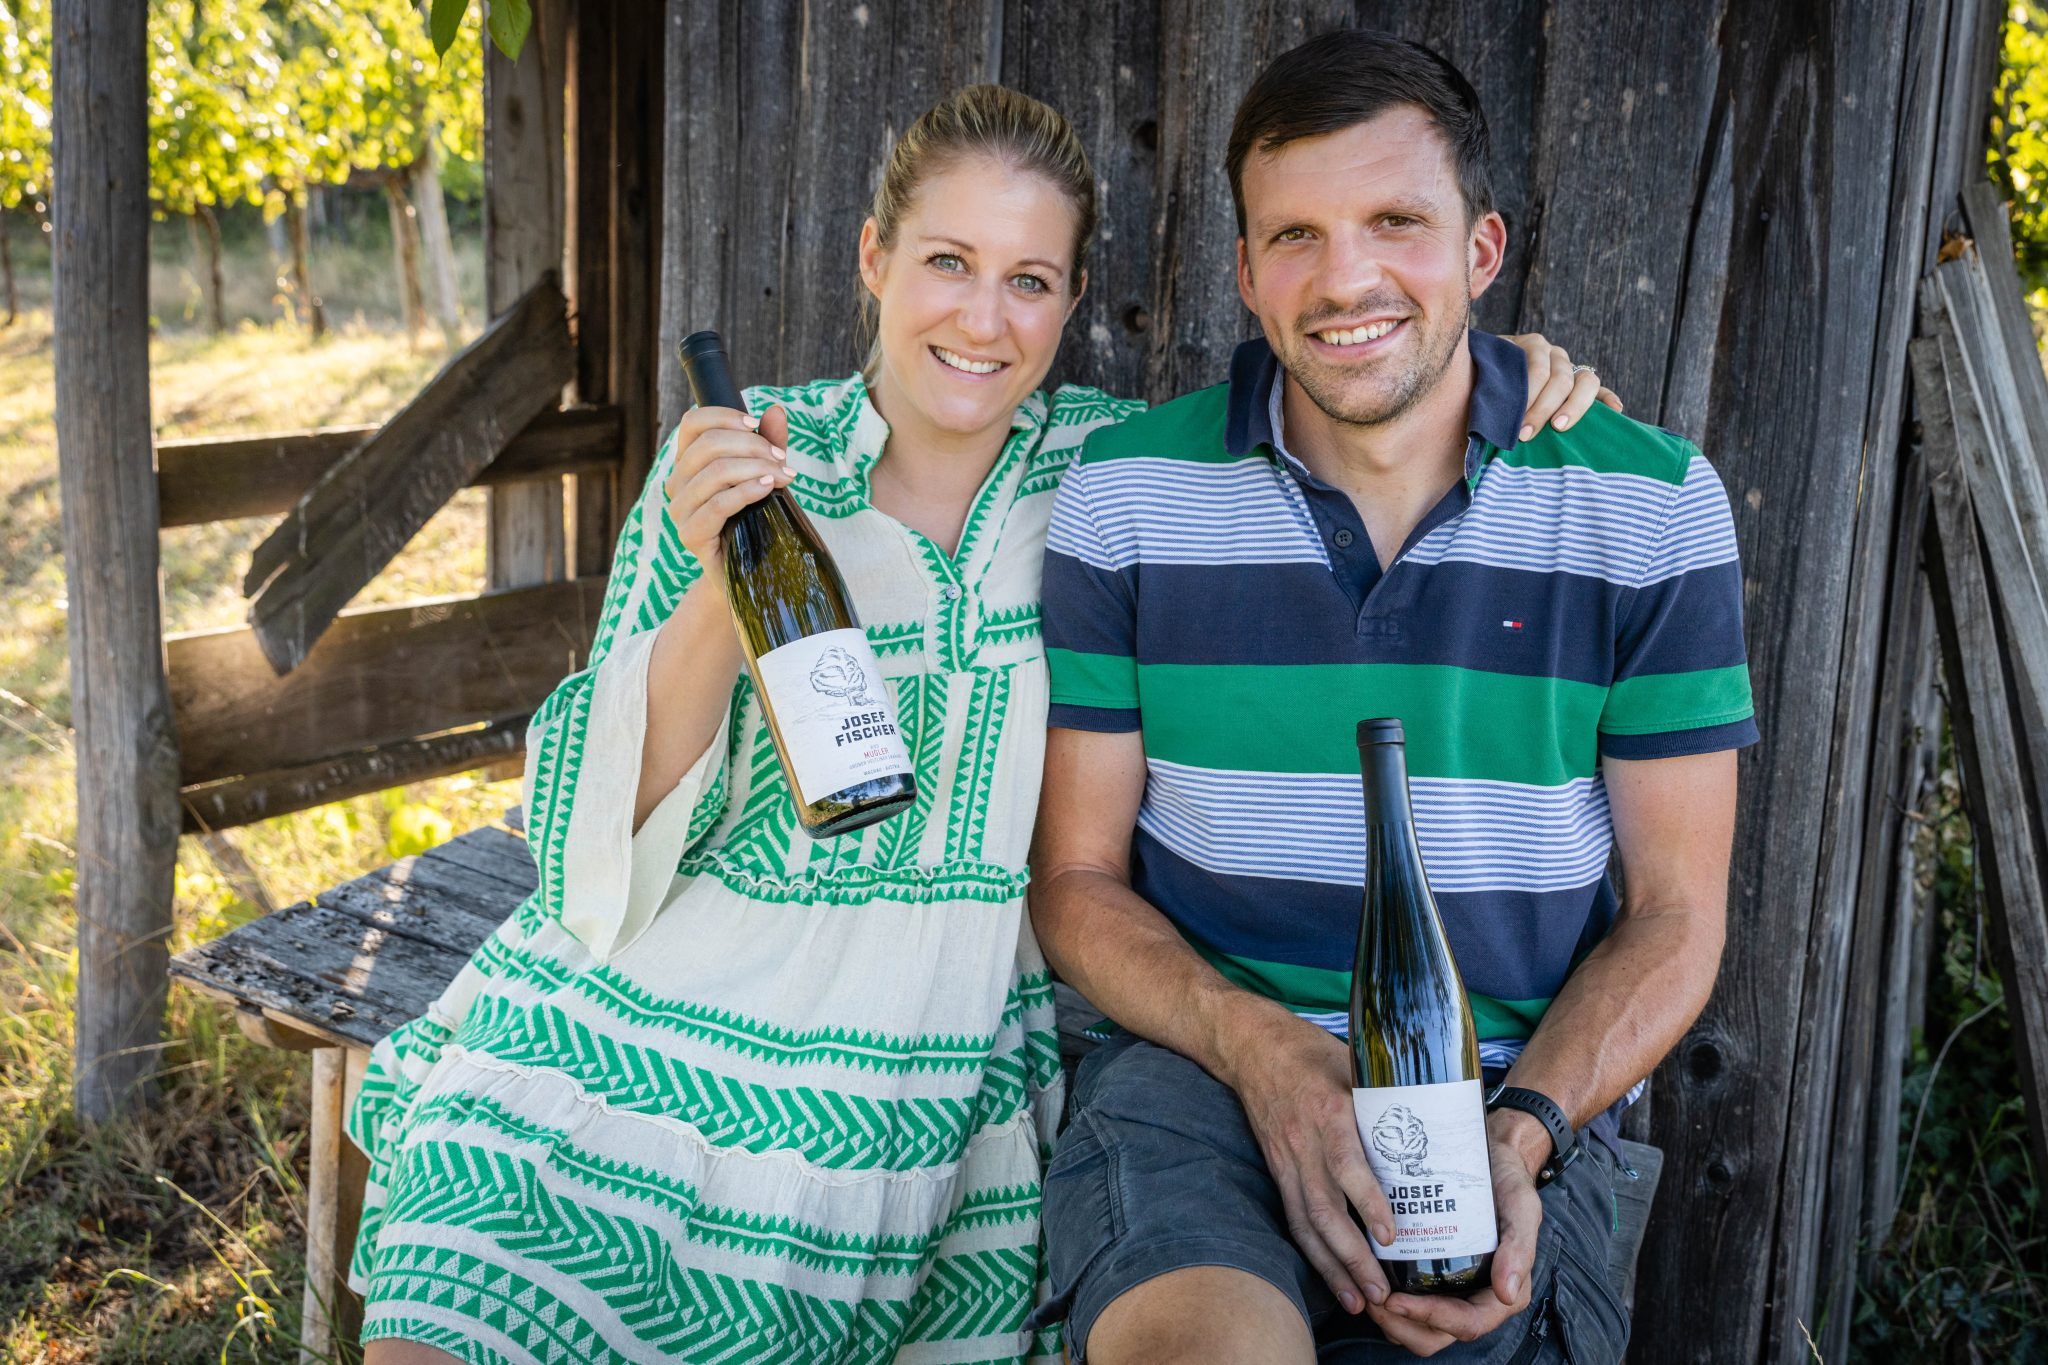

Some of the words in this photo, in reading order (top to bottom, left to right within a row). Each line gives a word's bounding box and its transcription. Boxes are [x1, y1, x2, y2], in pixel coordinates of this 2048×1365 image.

[841, 711, 886, 731] JOSEF
[835, 724, 896, 747] FISCHER
[864, 747, 889, 759] MUGLER
[1388, 1184, 1444, 1200] JOSEF
[1390, 1199, 1457, 1215] ISCHER
[1396, 1224, 1458, 1237] UENWEINGÄRTEN
